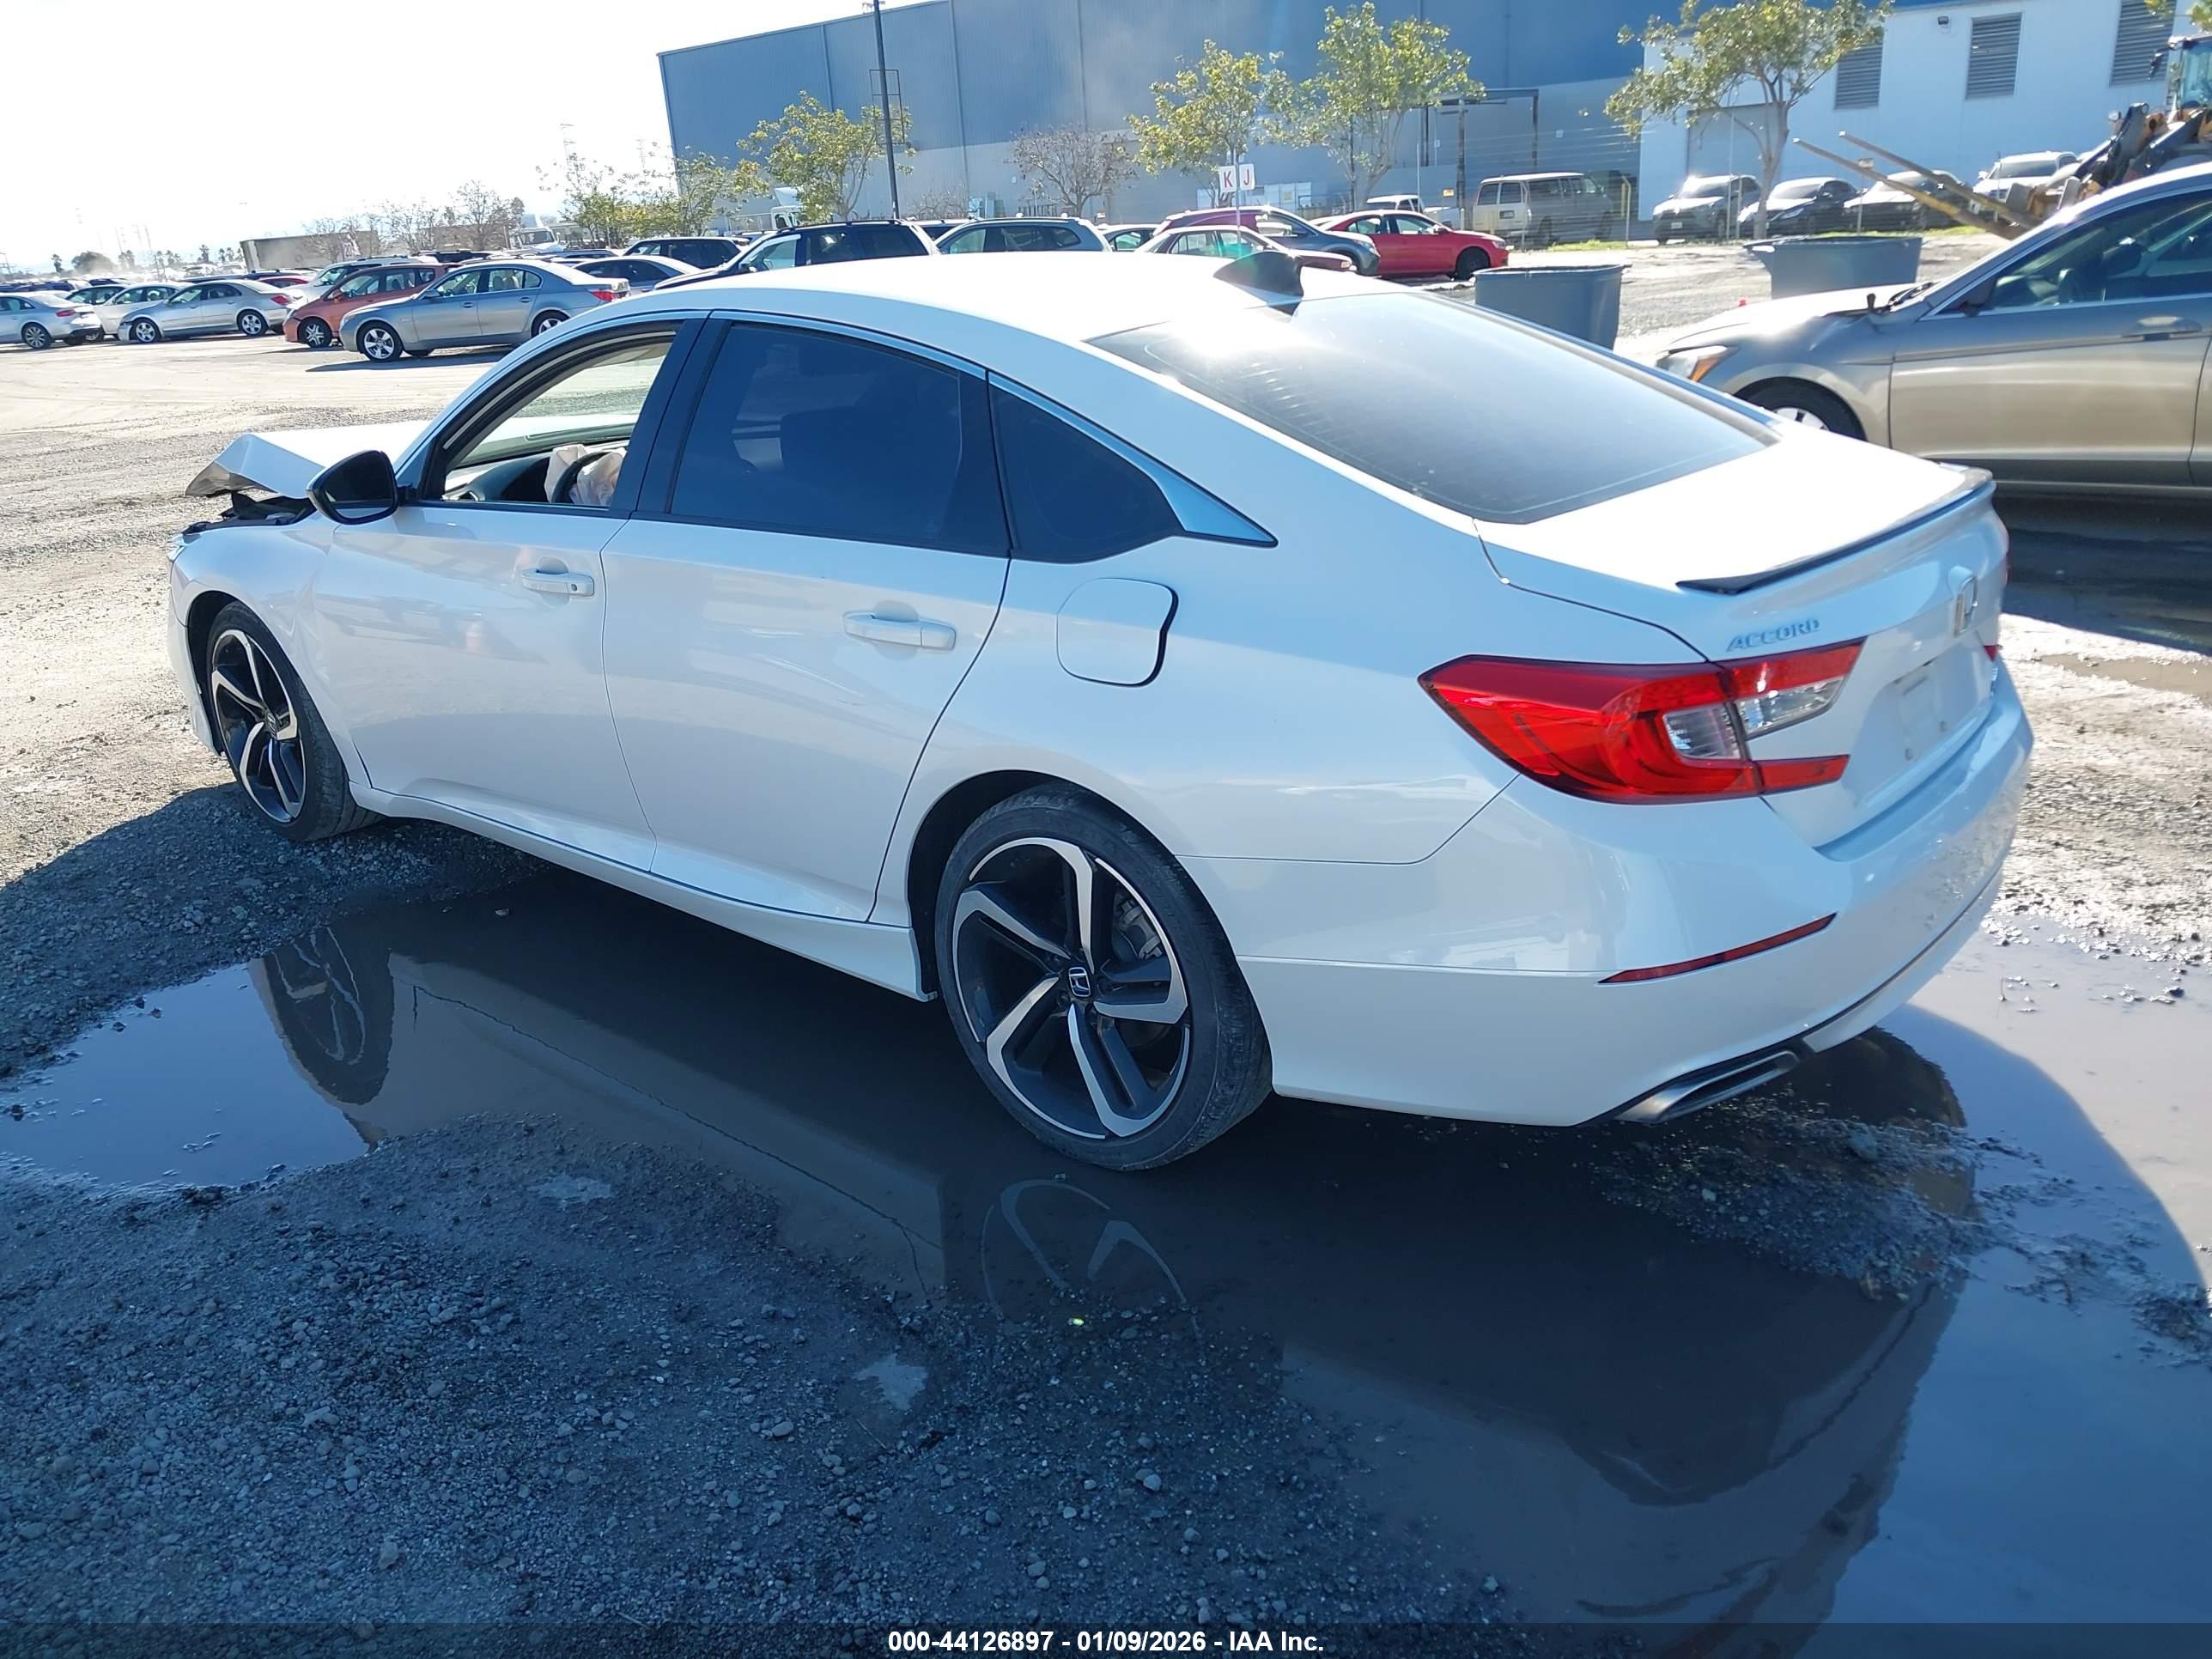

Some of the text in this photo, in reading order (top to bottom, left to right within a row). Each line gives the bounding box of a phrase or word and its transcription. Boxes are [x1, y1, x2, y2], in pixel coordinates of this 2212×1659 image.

[1224, 171, 1233, 188] K
[1243, 168, 1250, 185] J
[1726, 618, 1820, 653] ACCORD
